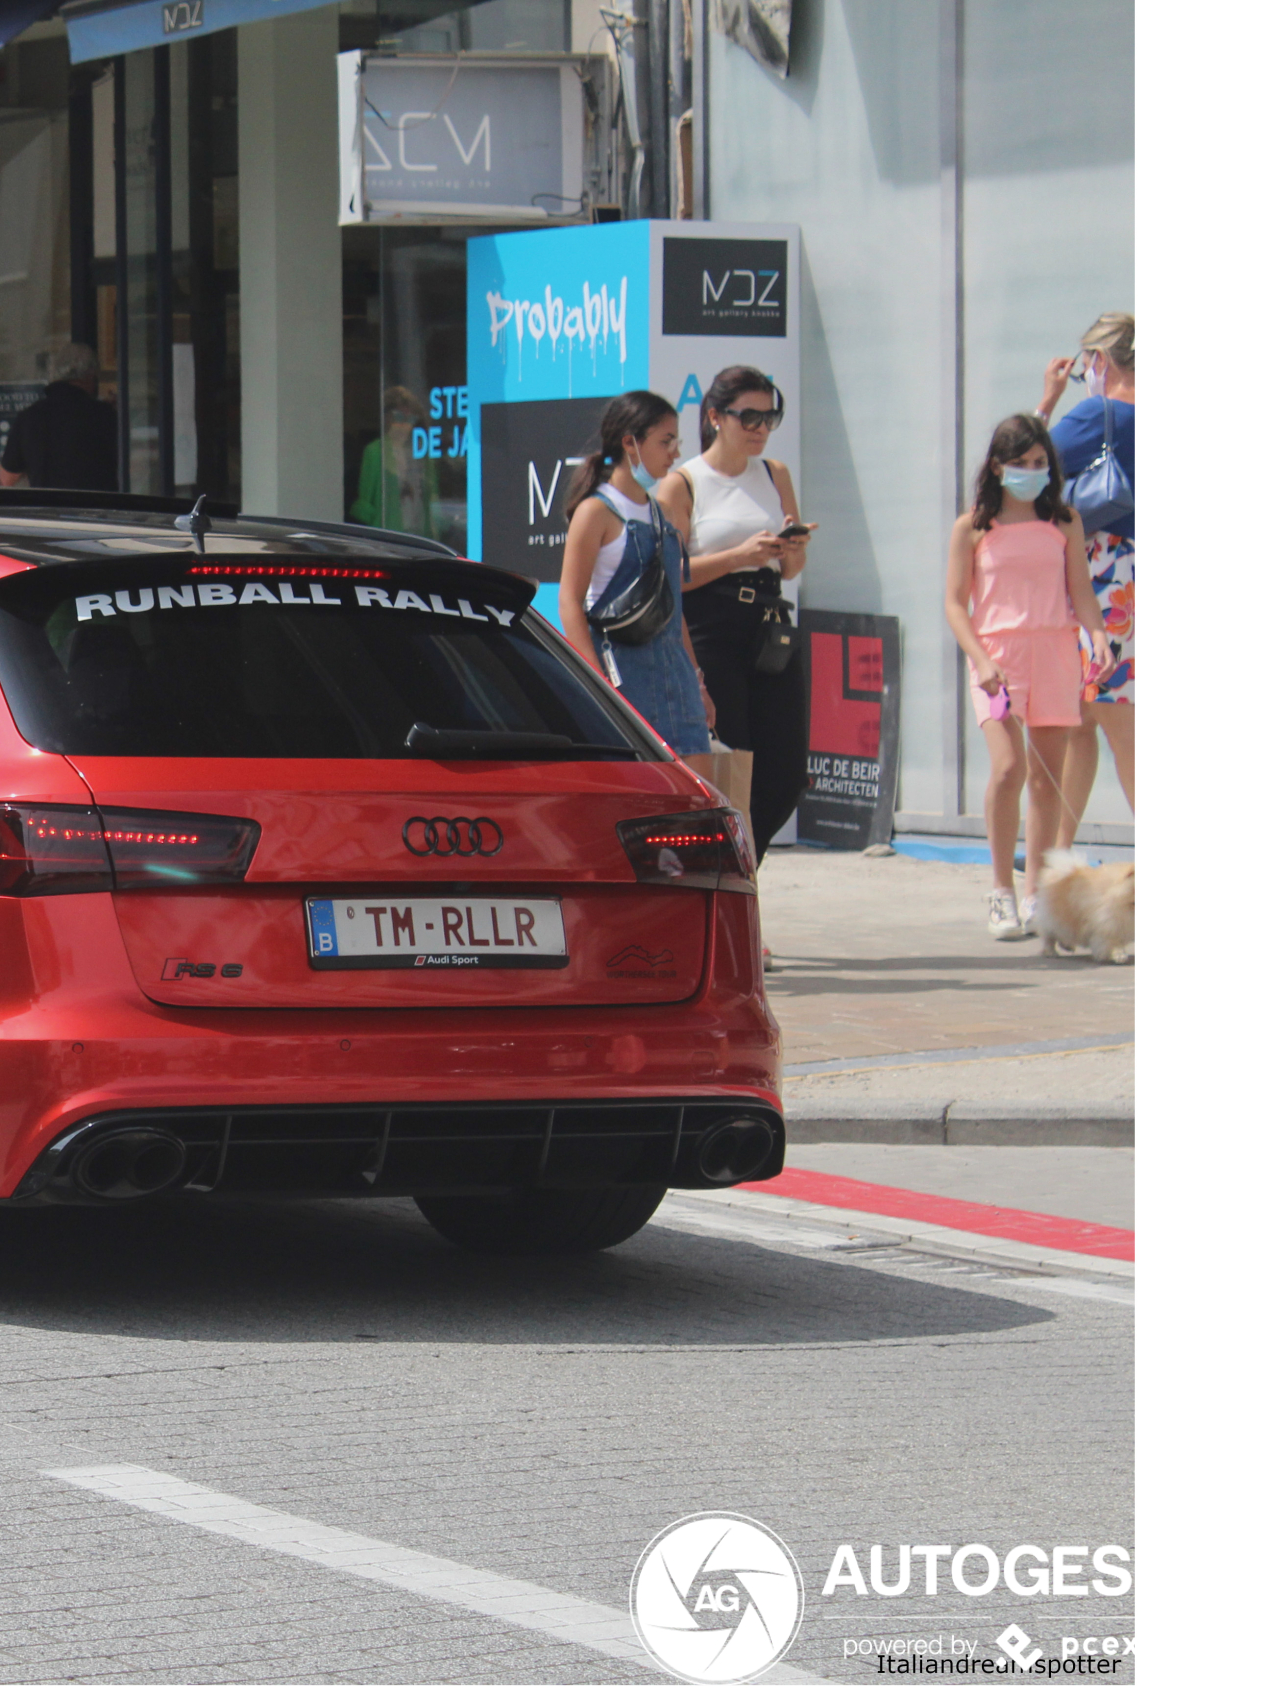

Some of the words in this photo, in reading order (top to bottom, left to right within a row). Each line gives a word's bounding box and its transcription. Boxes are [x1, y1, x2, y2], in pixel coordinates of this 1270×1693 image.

[703, 269, 779, 307] MDZ
[486, 276, 627, 363] Probably
[412, 426, 442, 459] DE
[528, 535, 544, 545] art
[76, 583, 341, 621] RUNBALL
[354, 586, 515, 627] RALLY
[807, 756, 831, 775] LUC
[833, 758, 850, 778] DE
[815, 776, 879, 798] ARCHITECTEN
[319, 933, 333, 951] B
[427, 955, 450, 964] Audi
[452, 955, 479, 966] Sport
